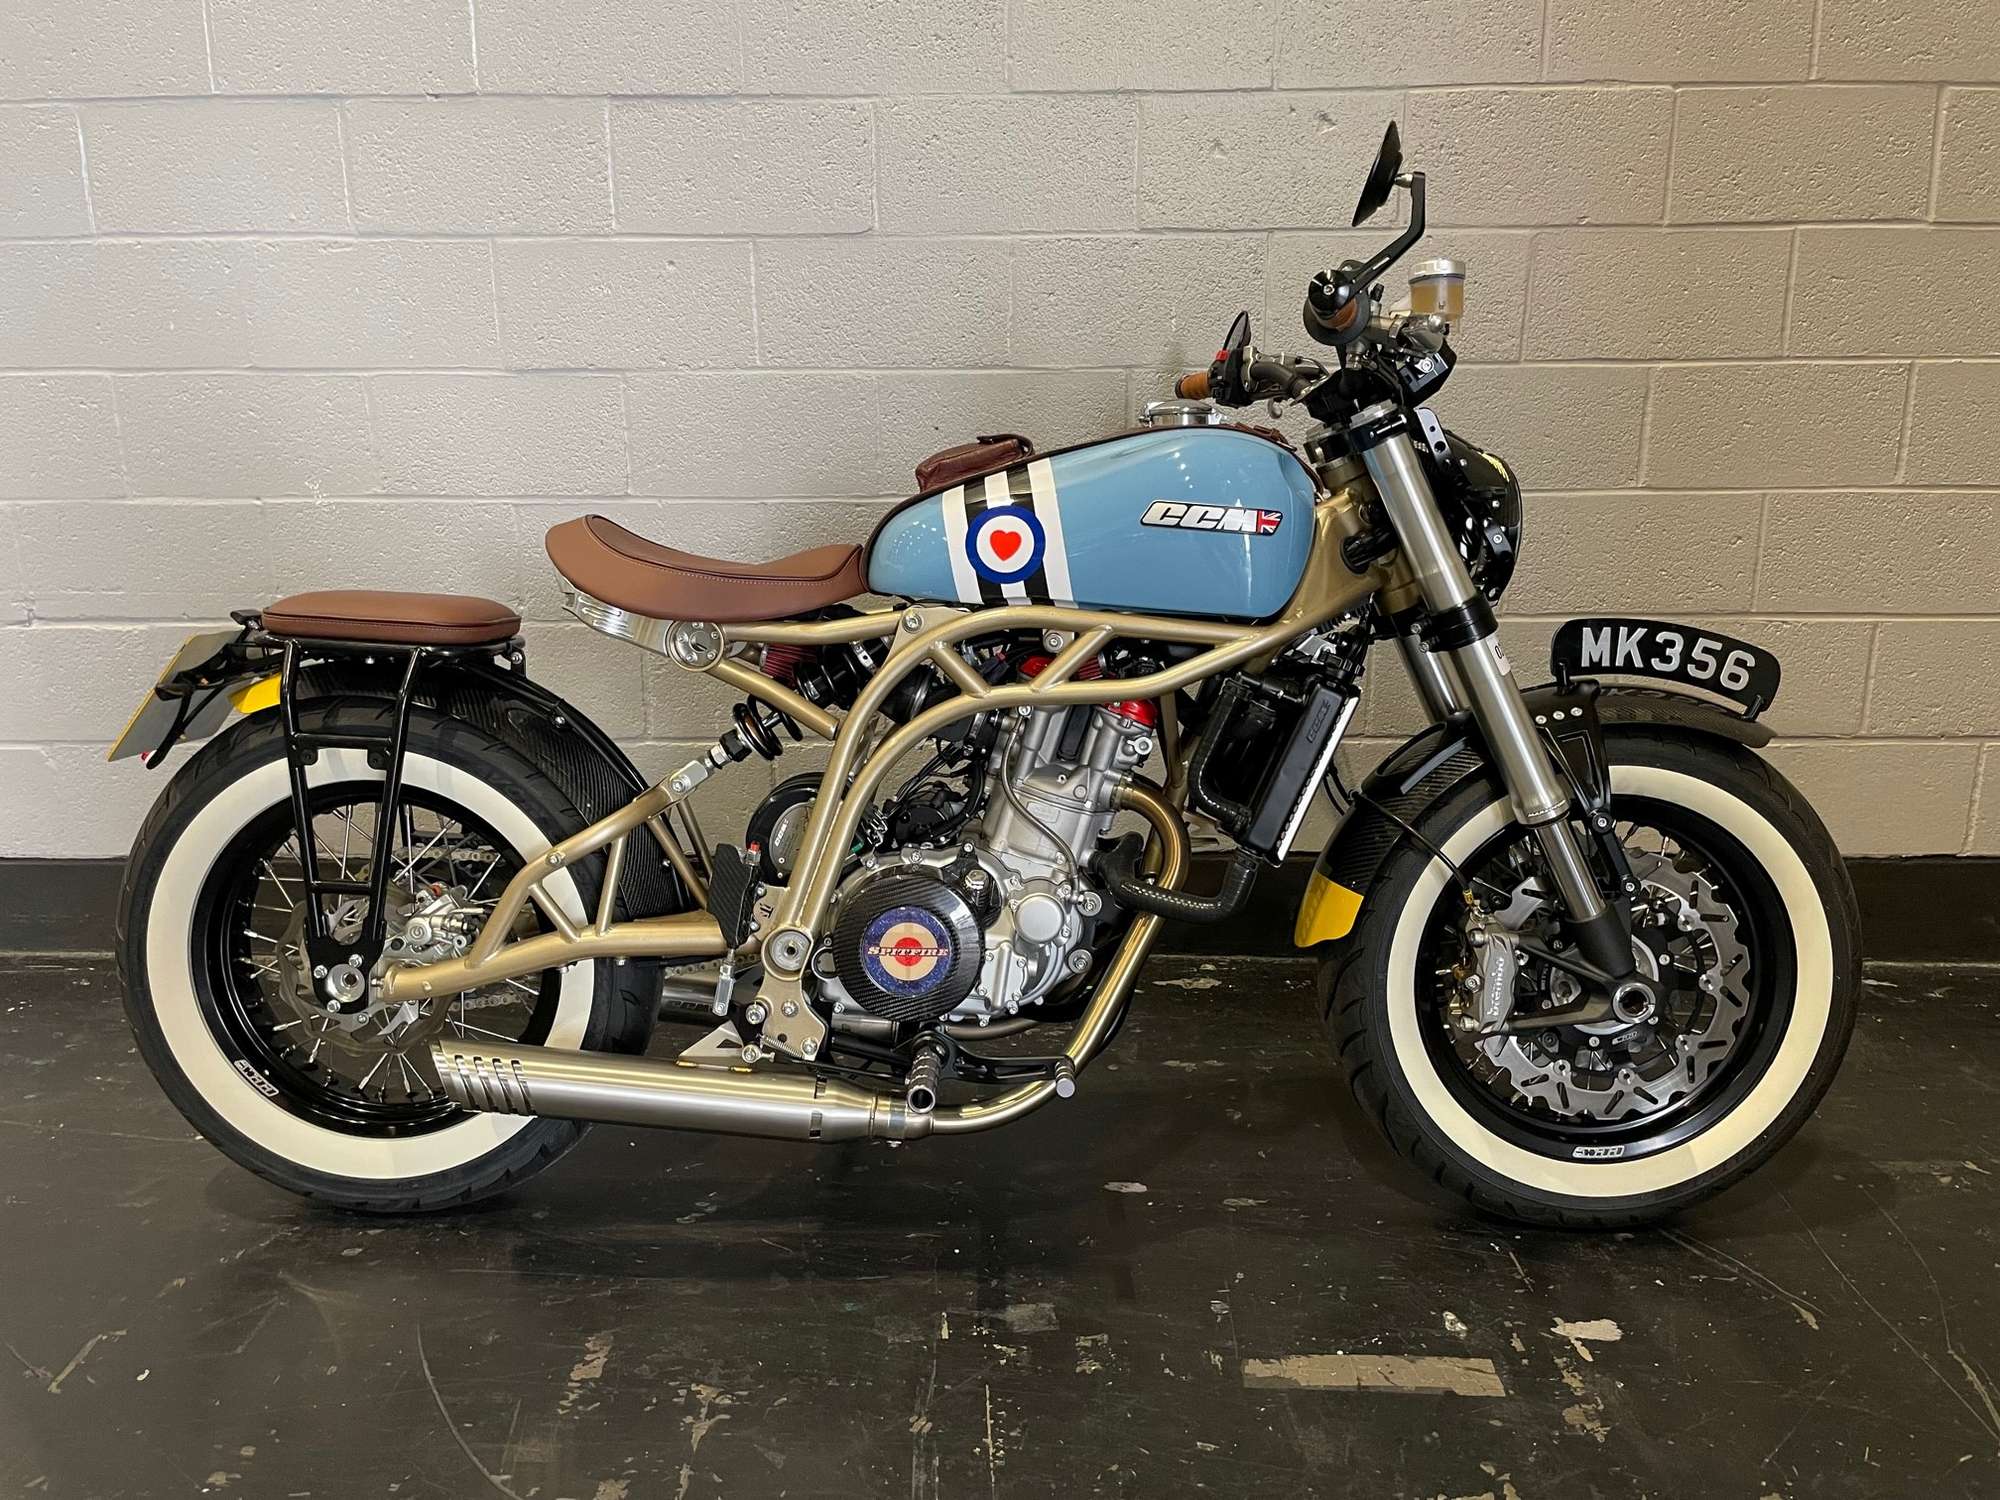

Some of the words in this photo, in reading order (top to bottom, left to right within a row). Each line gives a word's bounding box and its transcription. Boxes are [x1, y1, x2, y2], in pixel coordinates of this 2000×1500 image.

[1142, 501, 1257, 533] CCM
[1580, 626, 1756, 692] MK356
[867, 945, 949, 957] SPITFIRE
[1486, 957, 1505, 1017] brembo
